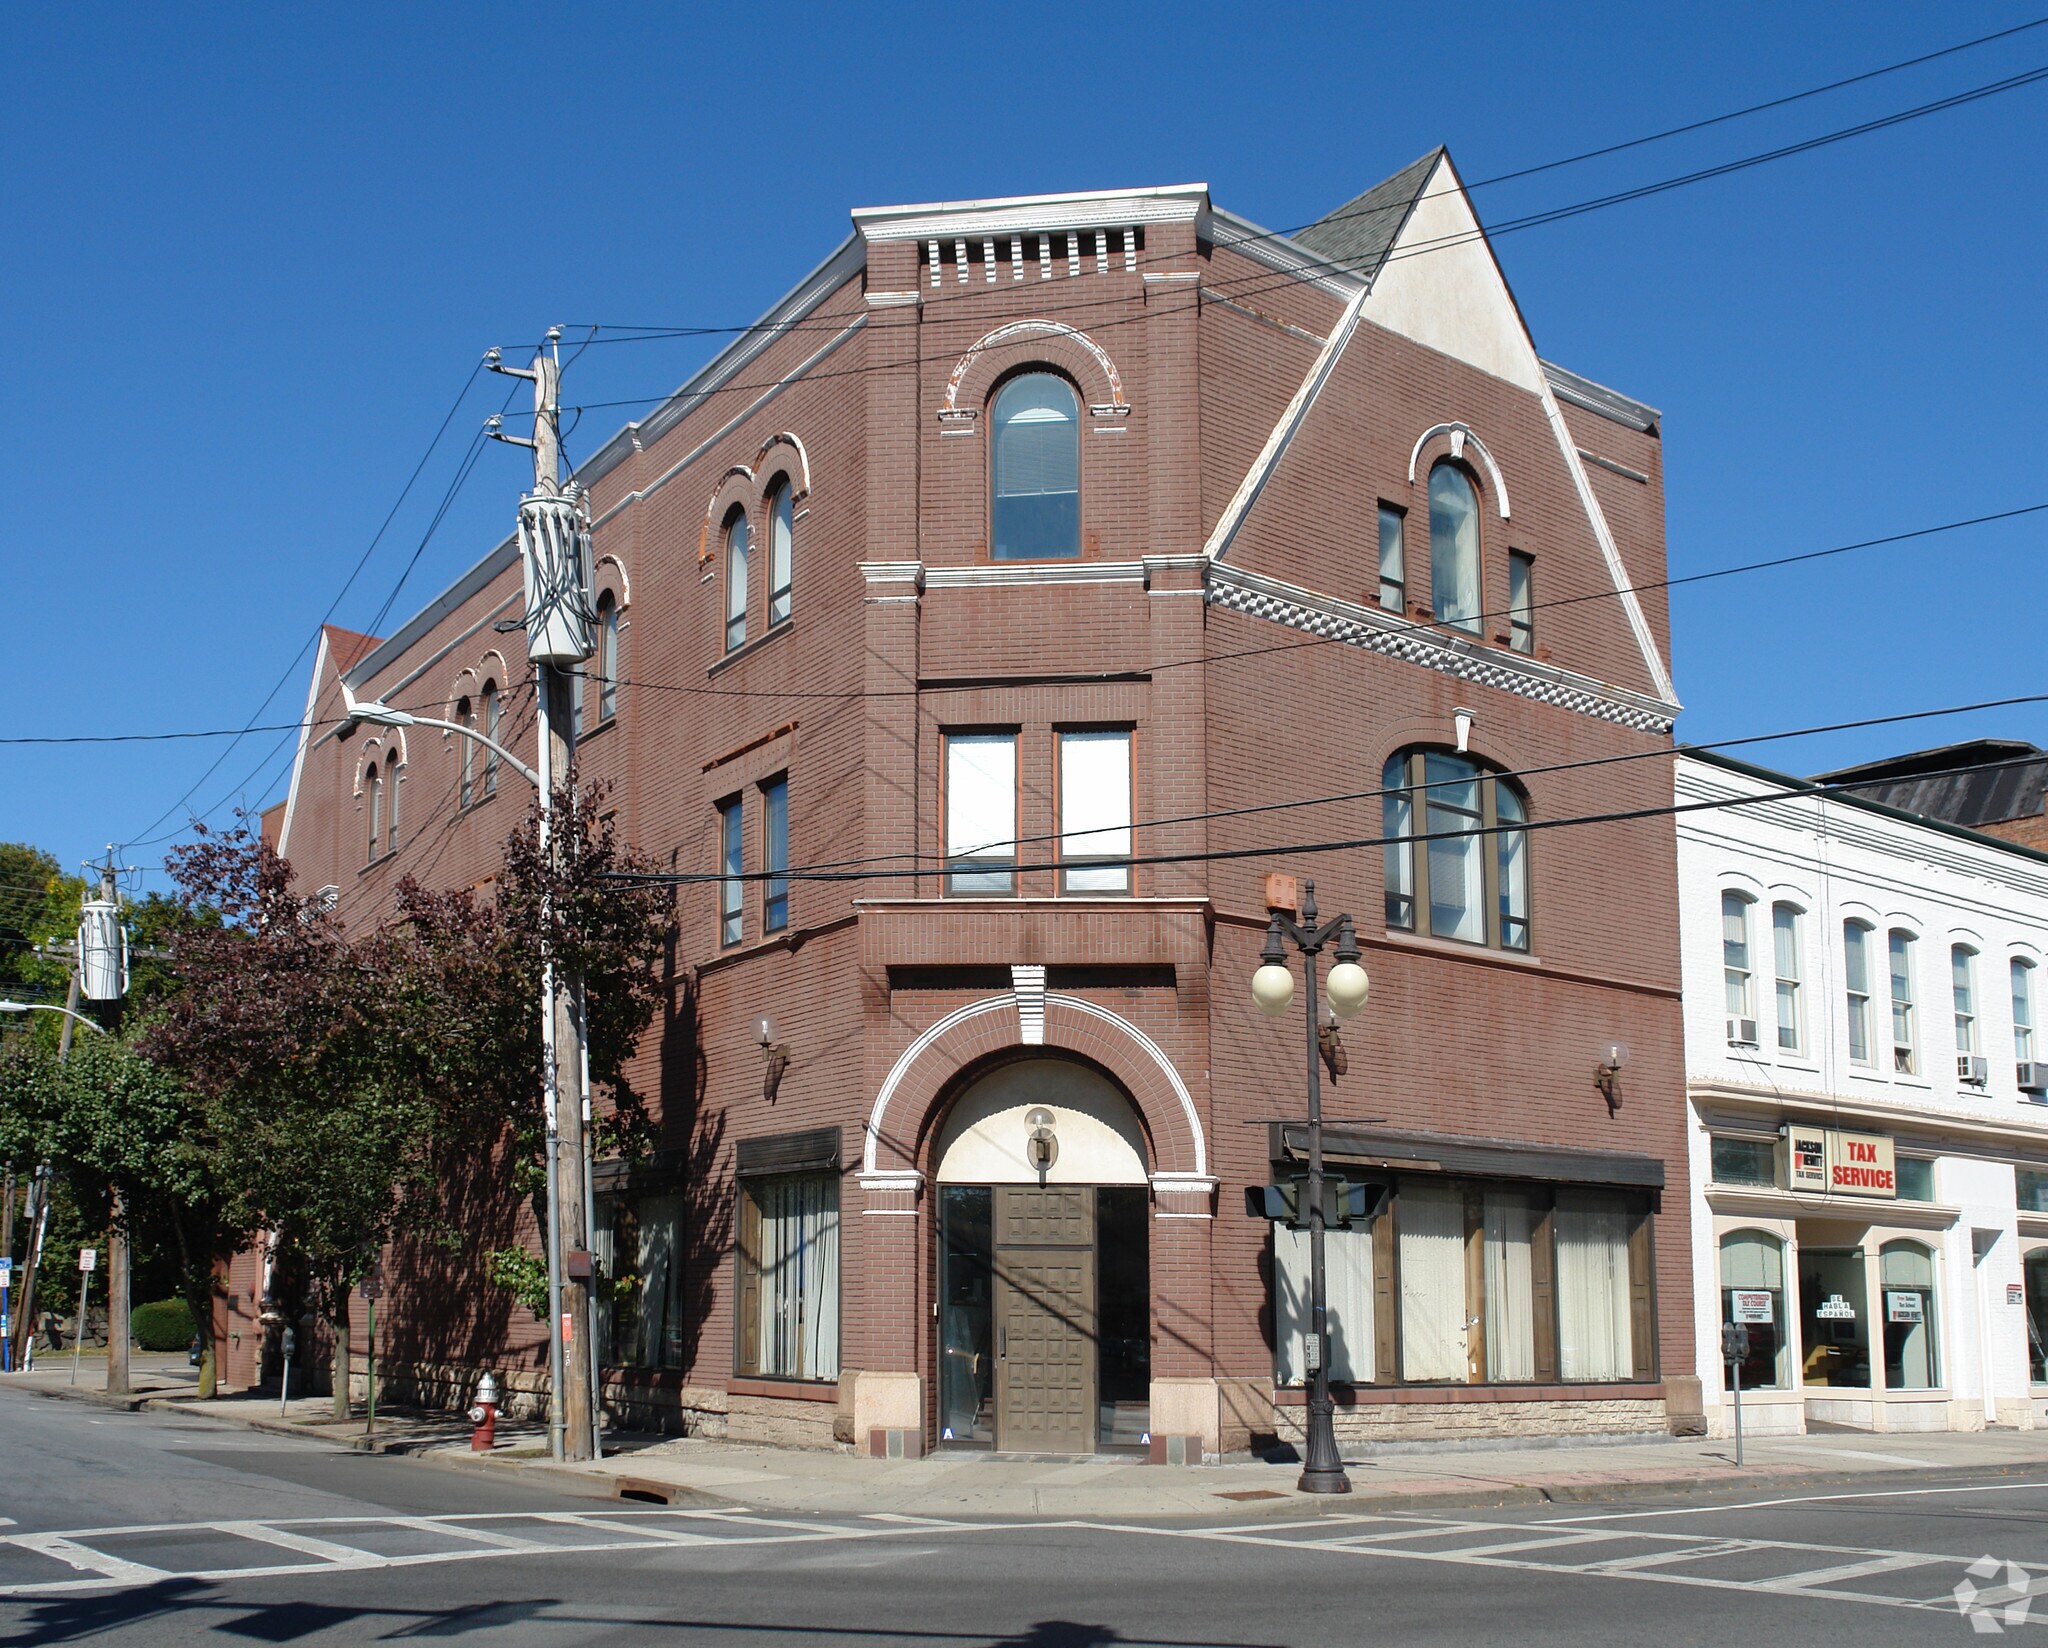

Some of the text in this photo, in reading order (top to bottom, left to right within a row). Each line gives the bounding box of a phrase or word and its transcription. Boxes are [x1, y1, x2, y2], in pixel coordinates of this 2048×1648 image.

[1795, 1139, 1823, 1154] JACKSON
[1847, 1141, 1877, 1163] TAX
[1796, 1170, 1824, 1180] TAX SERVICE
[1833, 1165, 1894, 1189] SERVICE
